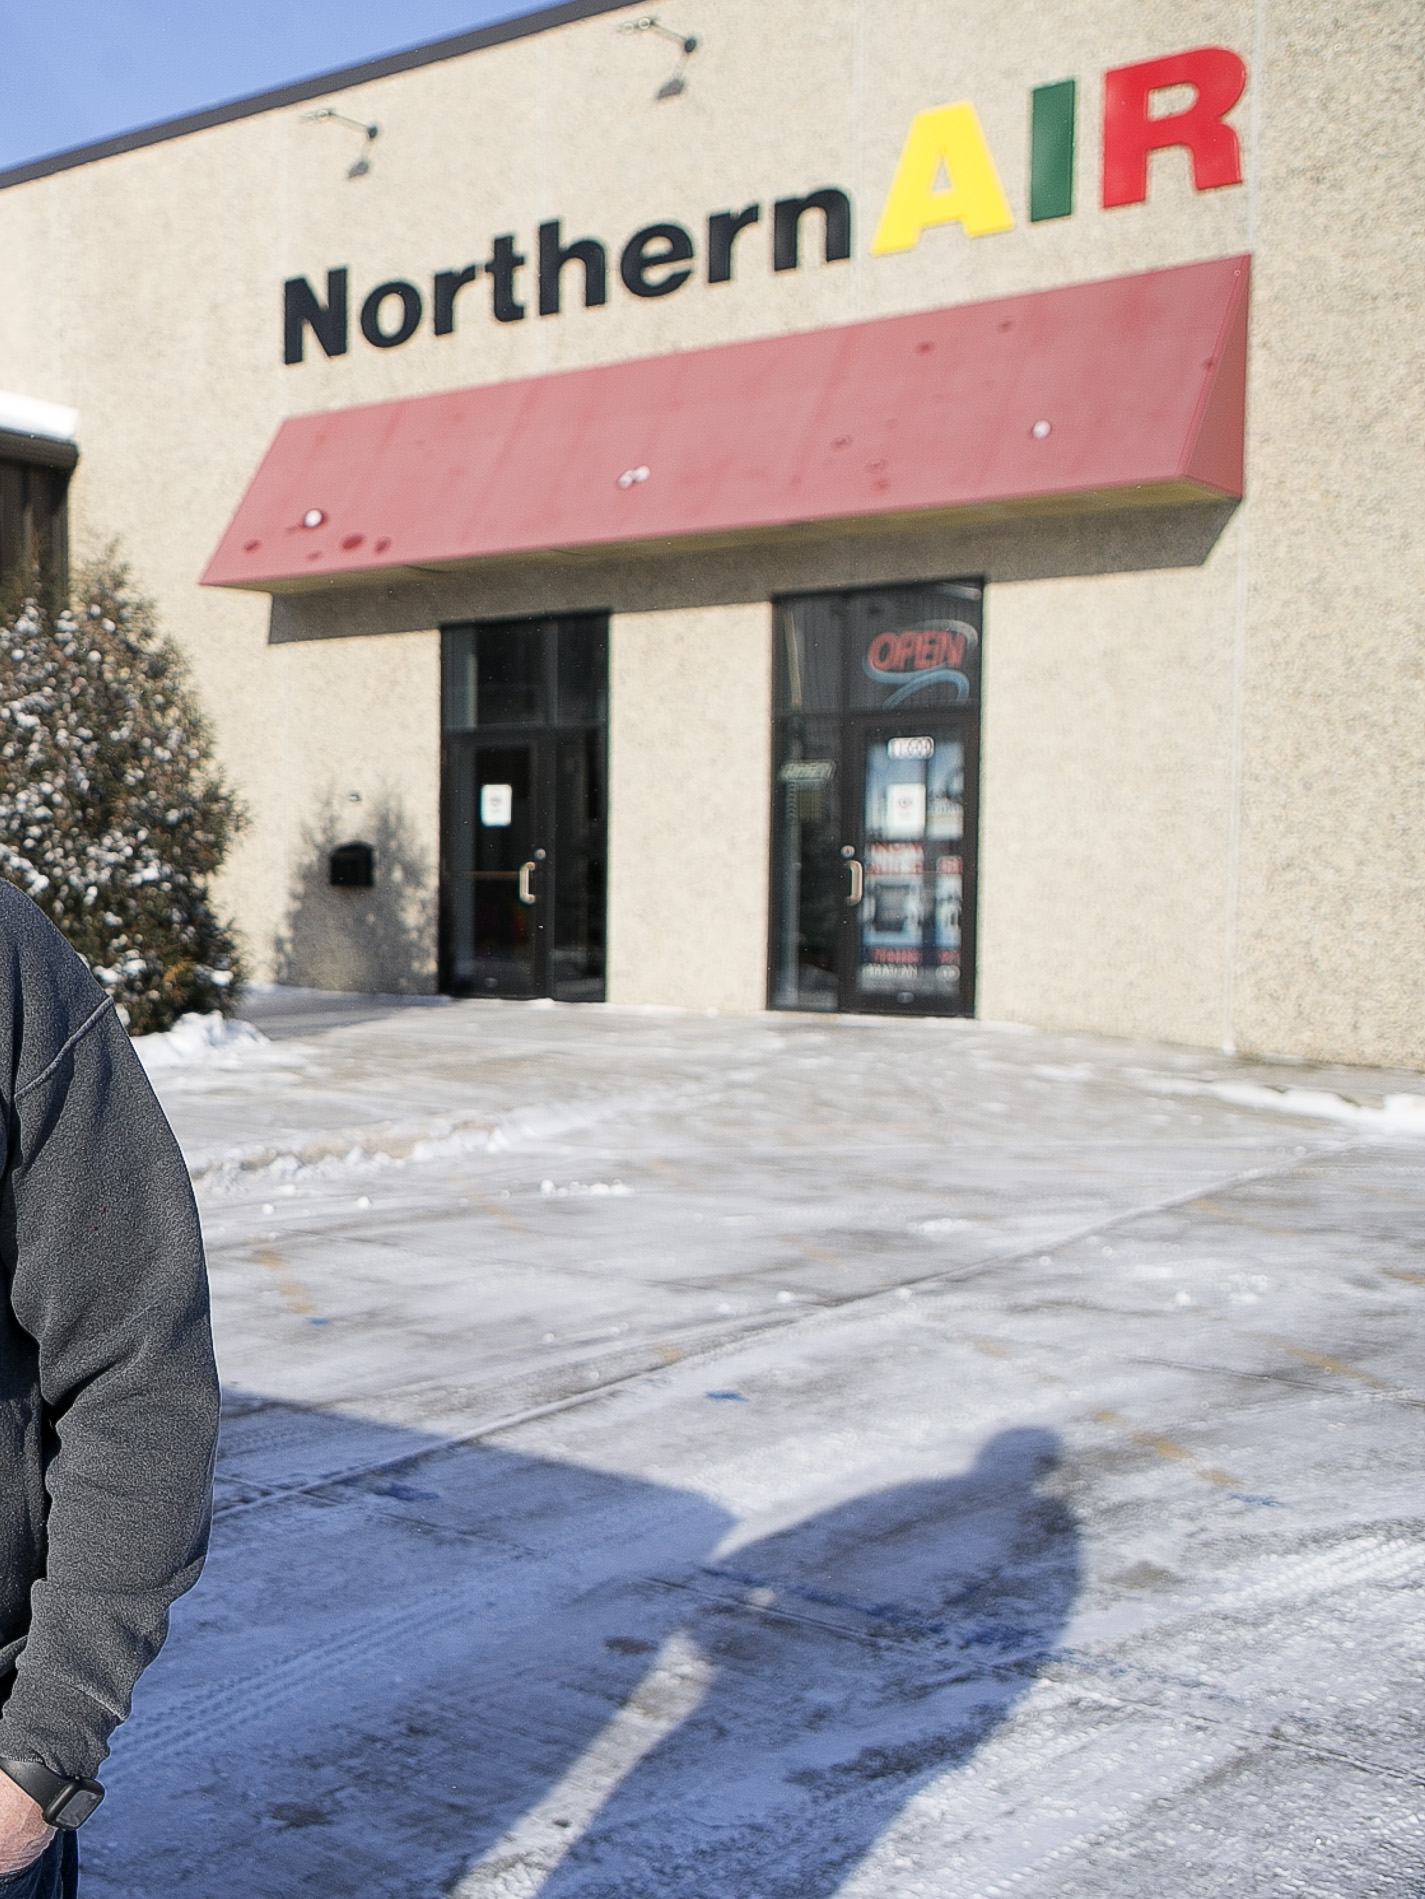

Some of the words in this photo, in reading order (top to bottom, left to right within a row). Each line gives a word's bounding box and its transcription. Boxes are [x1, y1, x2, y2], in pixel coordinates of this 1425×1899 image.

[282, 185, 852, 365] Northern
[869, 46, 1247, 258] AIR
[867, 630, 965, 671] OPEN
